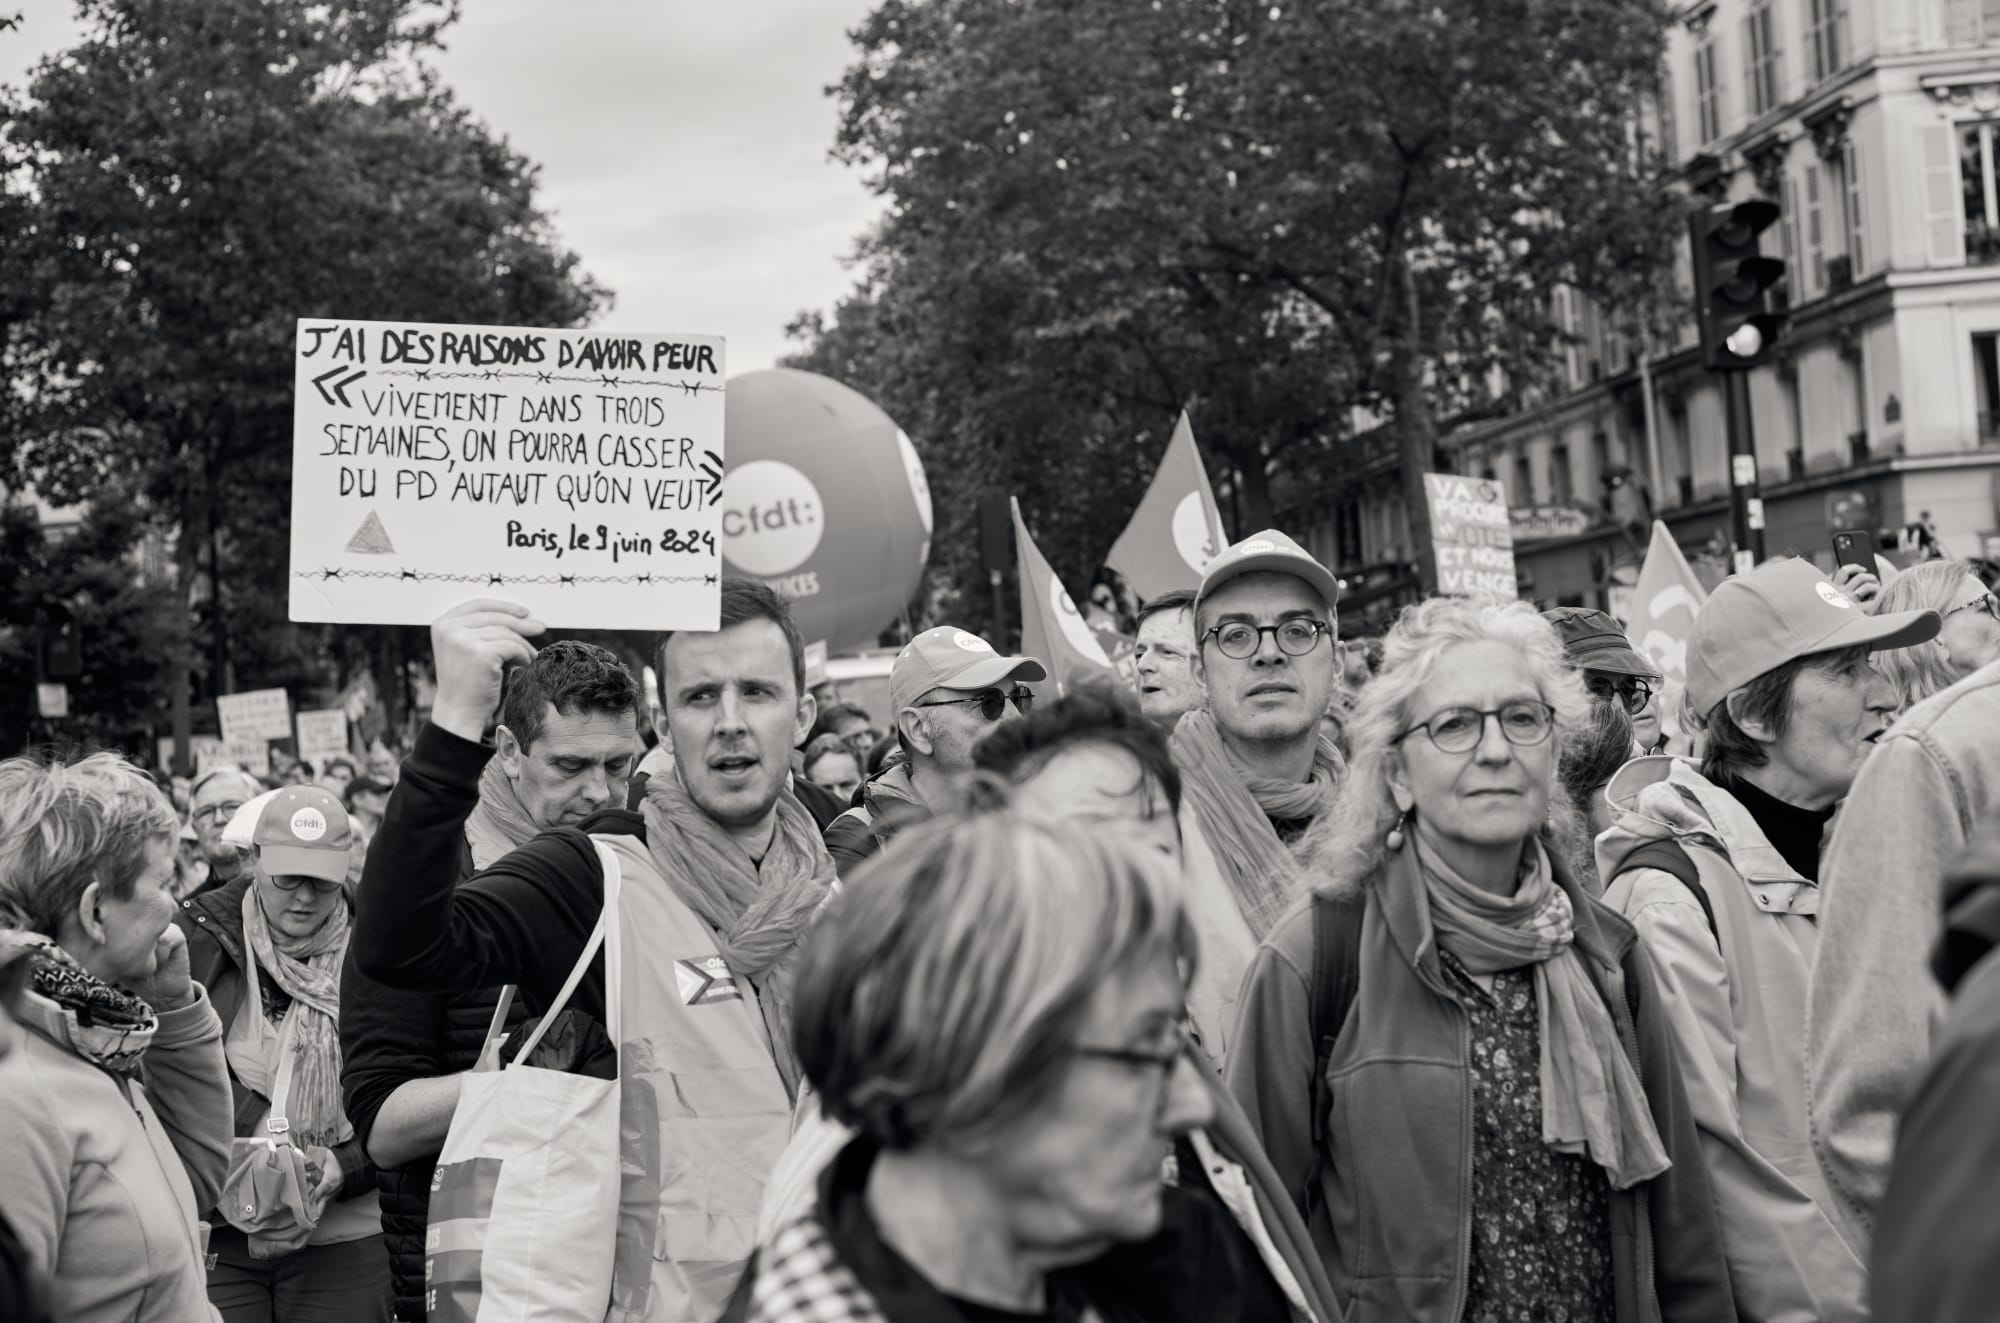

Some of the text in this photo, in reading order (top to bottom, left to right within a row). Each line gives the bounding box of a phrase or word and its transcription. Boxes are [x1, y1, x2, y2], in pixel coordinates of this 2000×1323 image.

[301, 325, 718, 374] J'AI DES RAISONS D'AVOIR PEUR
[520, 394, 583, 423] DANS
[595, 395, 665, 427] TROIS
[319, 423, 456, 474] SEMAINES,
[463, 428, 496, 462] ON
[508, 429, 588, 465] POURRA
[598, 433, 696, 471] CASSER
[339, 466, 377, 498] DU
[396, 469, 438, 500] PD
[556, 470, 632, 512] QU'ON
[644, 478, 711, 512] VEUT
[506, 520, 715, 563] Paris, le 9 juin 2024
